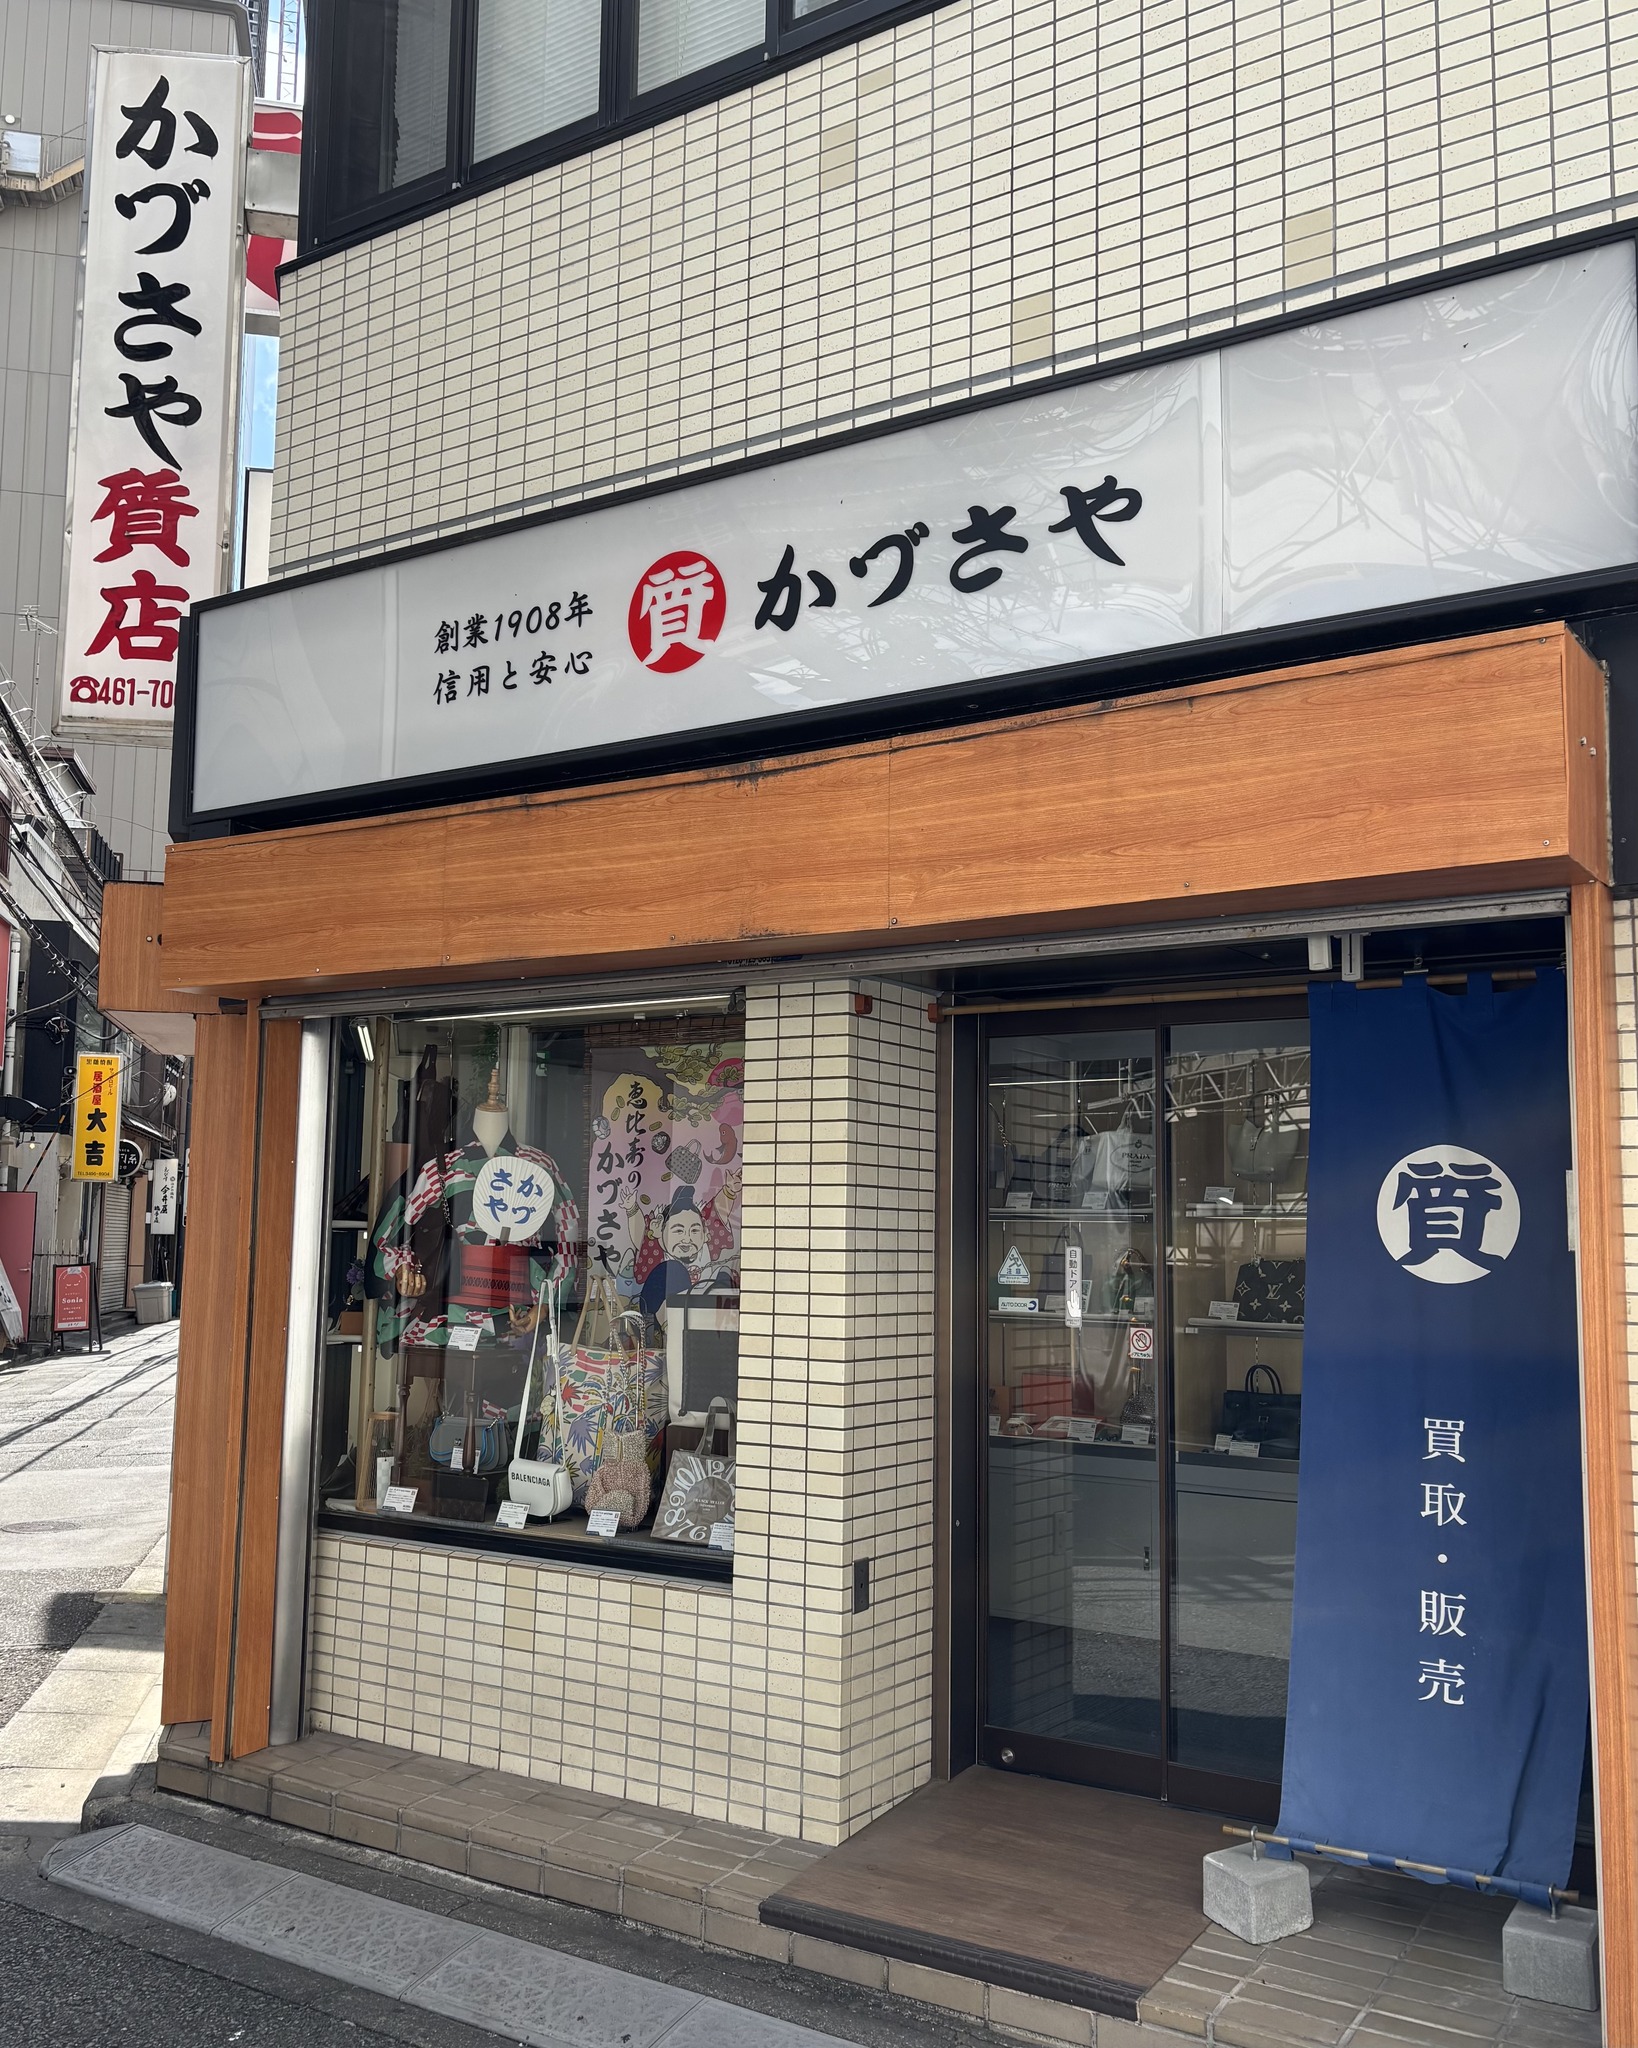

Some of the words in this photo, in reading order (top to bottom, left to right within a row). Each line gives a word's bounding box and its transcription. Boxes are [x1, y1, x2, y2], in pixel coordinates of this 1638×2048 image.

[755, 475, 1143, 632] かづさや
[434, 591, 593, 654] 創業1908年
[433, 651, 593, 705] 信用と安心
[92, 1071, 103, 1106] 居酒屋
[85, 1107, 108, 1166] 大吉
[625, 1081, 647, 1190] 恵比寿の
[1122, 1152, 1151, 1160] PRADA
[594, 1142, 625, 1281] かづさや
[1068, 1249, 1078, 1289] 自動ドア
[511, 1472, 551, 1487] BALENCIAGA
[706, 1459, 725, 1480] 12
[1417, 1416, 1468, 1706] 買取・販売
